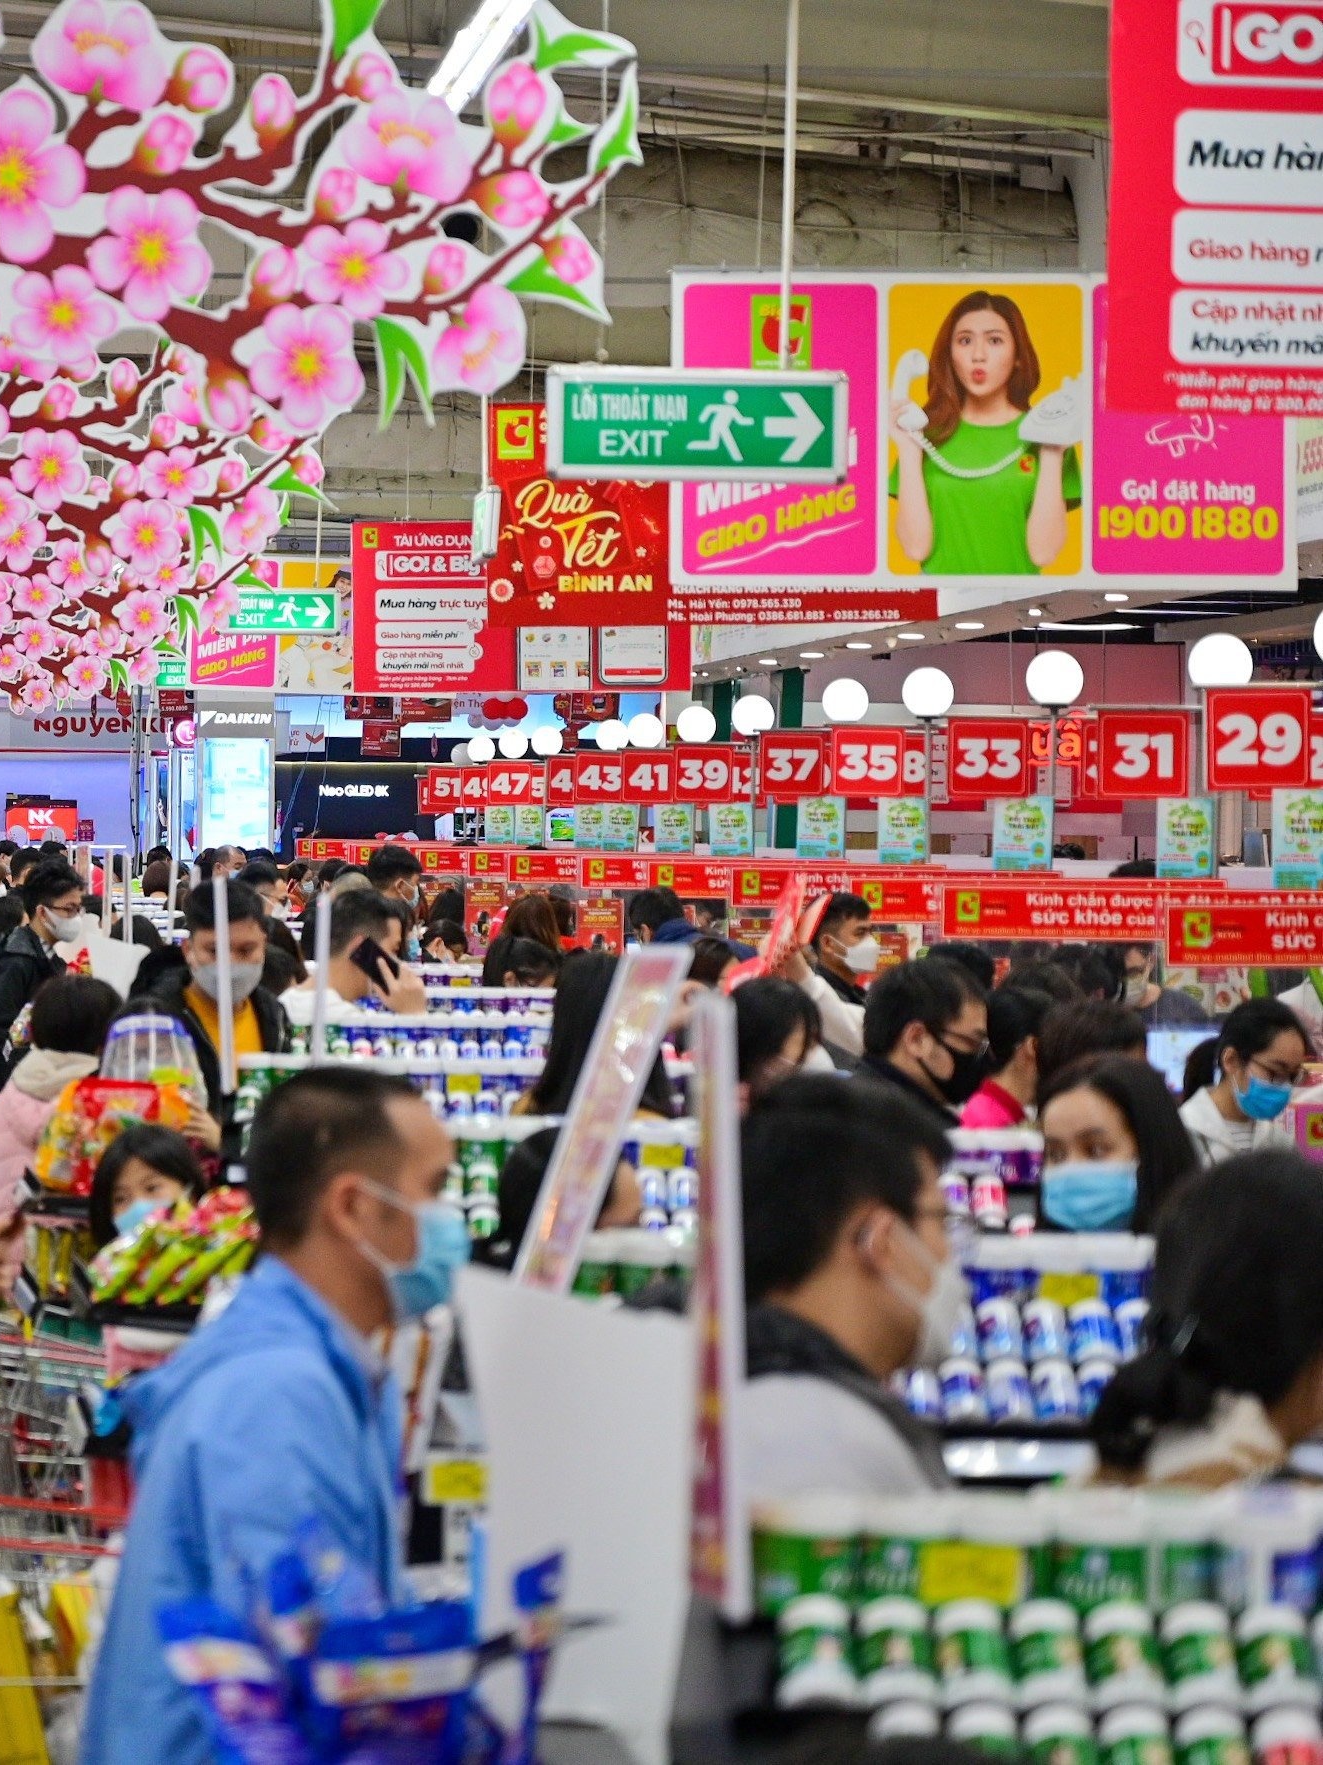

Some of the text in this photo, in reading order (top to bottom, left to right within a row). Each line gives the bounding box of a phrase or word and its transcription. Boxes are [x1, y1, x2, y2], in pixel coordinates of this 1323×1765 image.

[1188, 140, 1264, 171] Mua
[1189, 239, 1243, 260] Giao
[1250, 241, 1310, 267] hàng
[1191, 300, 1238, 324] Cập
[1245, 301, 1297, 324] nhật
[1191, 331, 1279, 358] khuyến
[572, 385, 688, 427] LỐI THOÁT NẠN
[599, 429, 670, 458] EXIT
[514, 478, 595, 530] Quà
[1121, 479, 1256, 506] Gọi đặt hàng
[698, 484, 857, 558] GIAO HÀNG
[1099, 504, 1279, 540] 1900 1880
[415, 532, 444, 547] ỨNG
[551, 510, 622, 568] Tết
[394, 555, 430, 572] GO!
[432, 555, 448, 572] &
[558, 570, 653, 592] BÌNH AN
[380, 599, 405, 609] Mua
[408, 598, 436, 612] hàng
[439, 599, 461, 611] trực
[667, 599, 686, 609] Ms.
[236, 613, 266, 625] EXIT
[667, 611, 686, 621] Ms.
[689, 612, 713, 622] Hoài
[401, 630, 421, 642] hàng
[422, 630, 444, 639] miễn
[445, 630, 458, 643] phí
[197, 647, 267, 677] GIAO HÀNG
[383, 651, 443, 661] Cập nhật những
[383, 660, 413, 671] khuyến
[430, 661, 445, 669] mới
[446, 660, 464, 669] nhất
[213, 712, 273, 724] DAIKIN
[1216, 713, 1303, 766] 29
[766, 749, 820, 781] 37
[838, 744, 898, 781] 35
[955, 738, 1022, 779] 33
[1113, 733, 1174, 779] 31
[491, 773, 530, 796] 47
[578, 766, 622, 791] 43
[628, 763, 669, 791] 41
[678, 759, 729, 790] 39
[319, 785, 344, 797] Neo
[345, 784, 374, 797] QLED
[434, 777, 461, 797] 51
[28, 809, 56, 826] NK
[1110, 893, 1154, 909] được
[1031, 908, 1156, 925] sức khỏe của
[1271, 928, 1316, 951] sức
